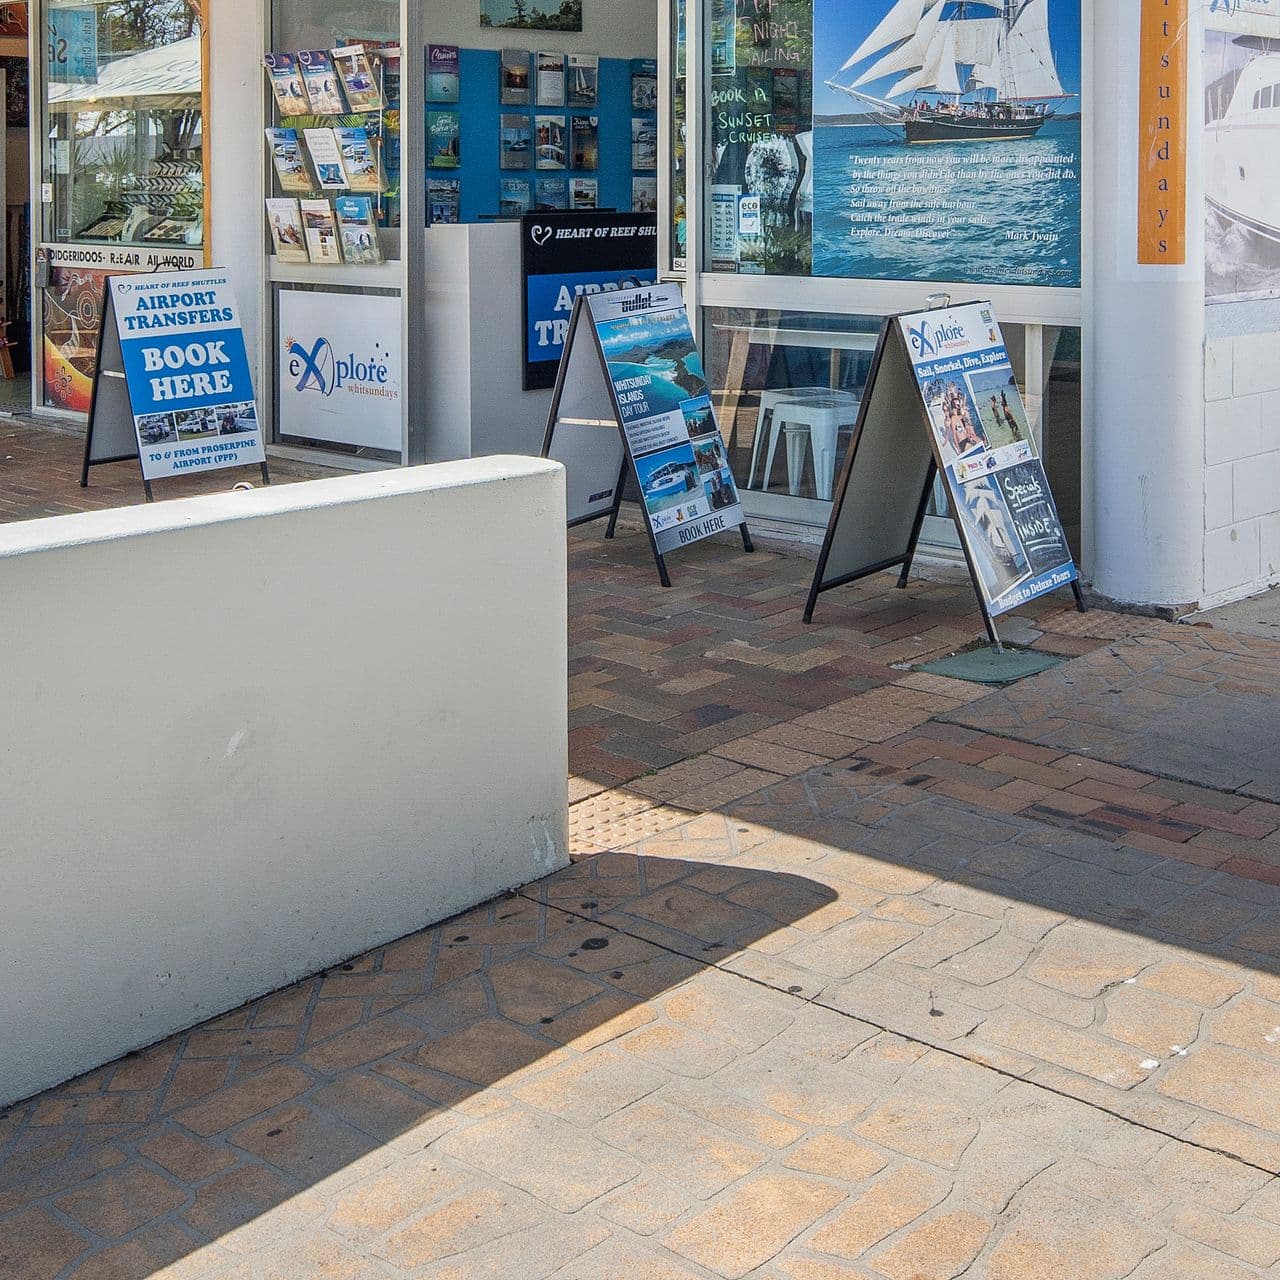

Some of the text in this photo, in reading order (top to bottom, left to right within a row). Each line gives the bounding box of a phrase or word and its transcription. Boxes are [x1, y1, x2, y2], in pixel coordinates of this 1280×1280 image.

[712, 88, 766, 106] BOOK A
[719, 112, 772, 129] SUNSET
[729, 132, 771, 143] CRUISE
[850, 199, 866, 209] Sail
[889, 200, 909, 210] from
[910, 200, 924, 208] the
[925, 200, 940, 210] safe
[555, 227, 636, 239] HEART OF REEF
[1005, 231, 1059, 241] Mark Twain
[136, 291, 216, 310] AIRPORT
[622, 292, 652, 313] bullet
[124, 308, 233, 330] TRANSFERS
[141, 340, 230, 371] BOOK
[917, 351, 1006, 377] Sail, Snorkel, Dive, Explore
[149, 371, 233, 401] HERE
[347, 383, 399, 400] whitsundays
[614, 374, 652, 392] WHITSUNDAY
[618, 390, 644, 404] ISLANDS
[621, 401, 650, 417] DAY TOUR
[149, 452, 162, 462] TO
[174, 447, 199, 458] FROM
[202, 439, 256, 454] PROSERPINE
[172, 453, 238, 469] AIRPORT (PPP)
[1005, 476, 1042, 505] Specials
[678, 516, 726, 543] BOOK HERE
[998, 570, 1070, 609] Budget to Deluxe Tours
